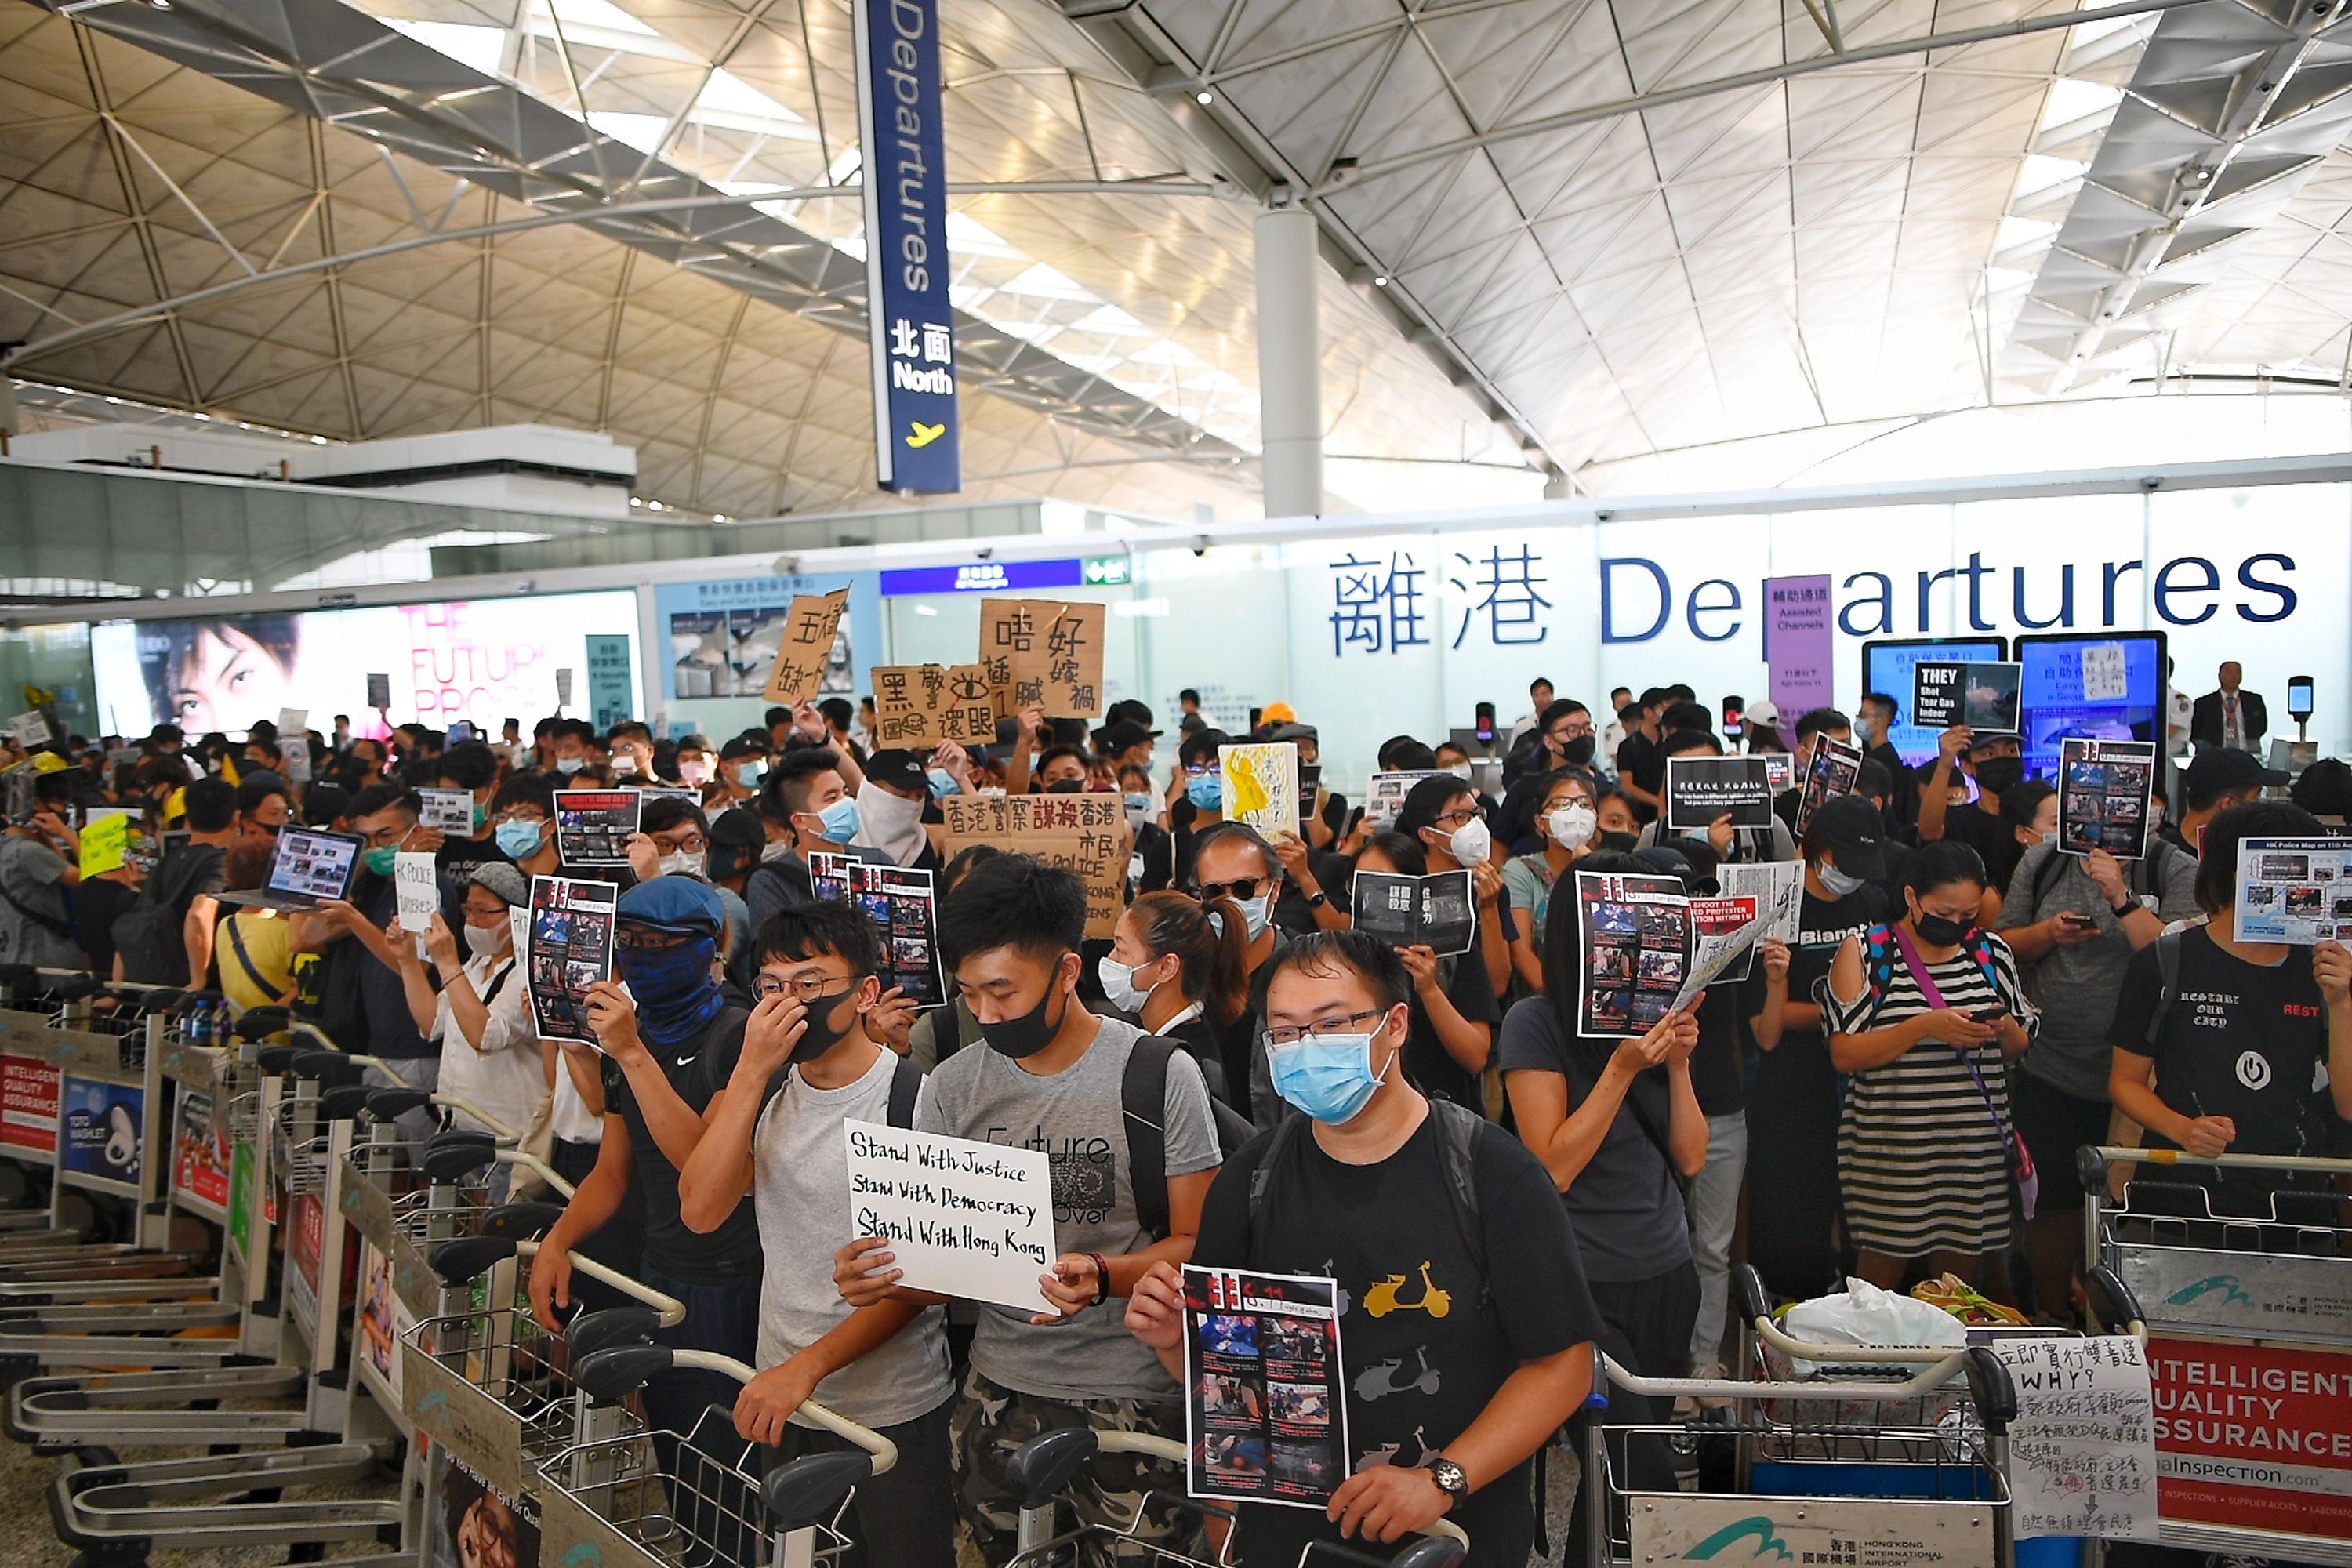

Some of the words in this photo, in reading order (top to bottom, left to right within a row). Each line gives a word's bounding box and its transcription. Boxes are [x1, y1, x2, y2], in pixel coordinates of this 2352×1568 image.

[887, 0, 930, 292] Departures
[891, 319, 952, 365] 北面
[892, 361, 953, 394] North
[1330, 543, 1552, 657] 離港
[1773, 588, 1828, 604] 輔助通道
[1601, 550, 2298, 662] Deartures
[1780, 608, 1822, 619] Assisted
[1777, 621, 1824, 631] Channels
[996, 614, 1087, 658] 唔好
[1920, 668, 1958, 685] THEY
[1920, 685, 1940, 696] Shot
[1919, 697, 1937, 706] Tear
[1939, 698, 1955, 708] Gas
[1919, 708, 1947, 718] Indoor
[938, 706, 995, 740] 還眼
[1078, 829, 1116, 860] 市民
[1053, 853, 1105, 878] POLICE
[1087, 908, 1112, 920] ZENS
[2180, 992, 2240, 1005] RESTART
[2196, 1004, 2225, 1015] OUR
[2283, 1004, 2320, 1017] REST
[2193, 1016, 2227, 1029] CITY
[4, 1079, 43, 1095] QUALITY
[4, 1093, 59, 1113] ASSURANCE
[851, 1131, 908, 1163] Stand
[917, 1144, 960, 1171] With
[962, 1151, 1029, 1183] Justice
[852, 1174, 894, 1197] Stand
[899, 1180, 937, 1204] With
[941, 1186, 1037, 1227] Democracy
[858, 1207, 913, 1243] Stand
[919, 1220, 960, 1250] With
[963, 1225, 1000, 1258] Hong
[1005, 1229, 1046, 1265] Kong
[2020, 1368, 2095, 1392] WHY?
[2147, 1358, 2352, 1397] NTELLIGENT
[2155, 1387, 2284, 1421] UALITY
[2154, 1416, 2351, 1458] SSURANCE
[496, 1489, 511, 1506] Eye
[2164, 1490, 2218, 1504] INSPECTIONS
[2228, 1496, 2268, 1508] SUPPLIER
[2268, 1501, 2299, 1513] AUDITS
[1830, 1538, 1857, 1552] 香港
[1864, 1541, 1894, 1549] HONG
[1802, 1552, 1857, 1566] 國際機場
[1864, 1551, 1944, 1561] INTERNATIONAL
